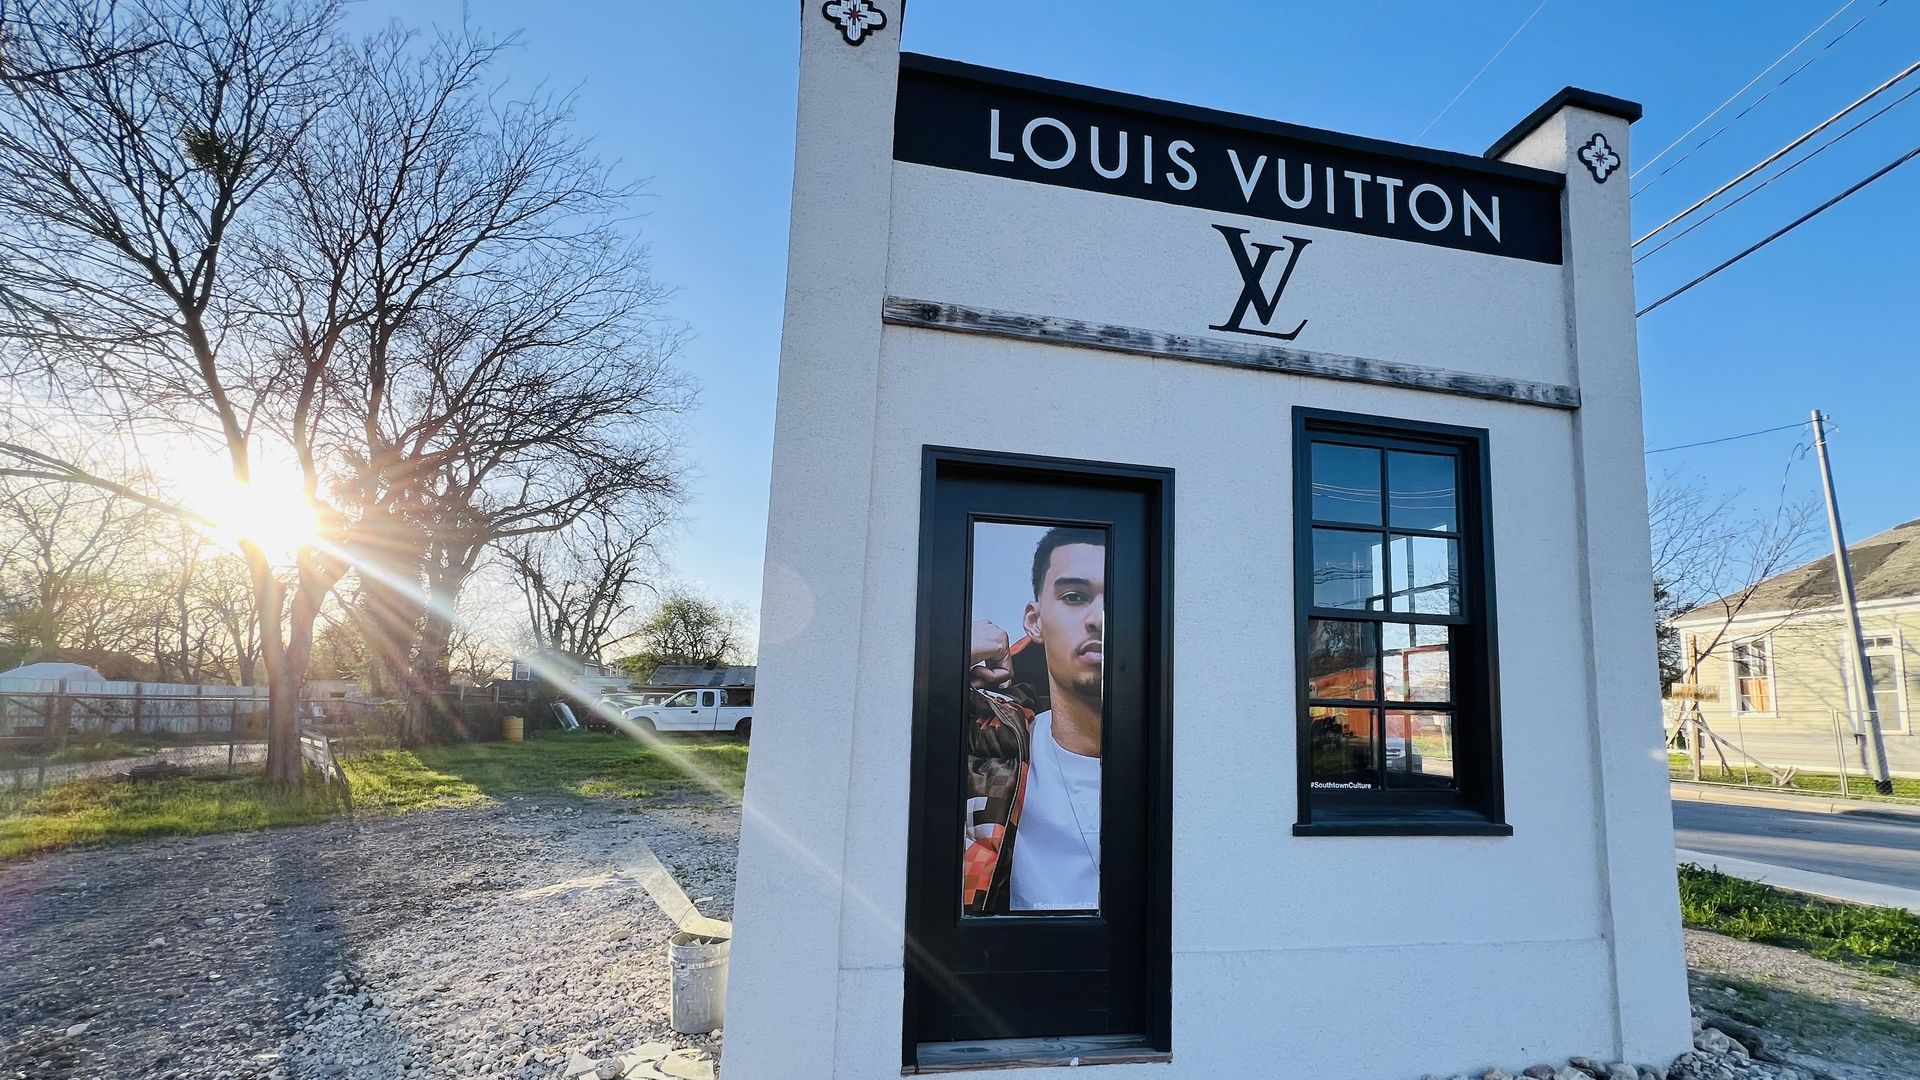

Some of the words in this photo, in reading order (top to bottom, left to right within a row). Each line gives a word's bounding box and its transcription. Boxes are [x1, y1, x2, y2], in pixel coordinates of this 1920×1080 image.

[988, 108, 1198, 192] LOUIS
[1226, 149, 1502, 245] VUITTON
[1209, 223, 1313, 341] LV
[1310, 781, 1372, 790] #SouthtownCulture
